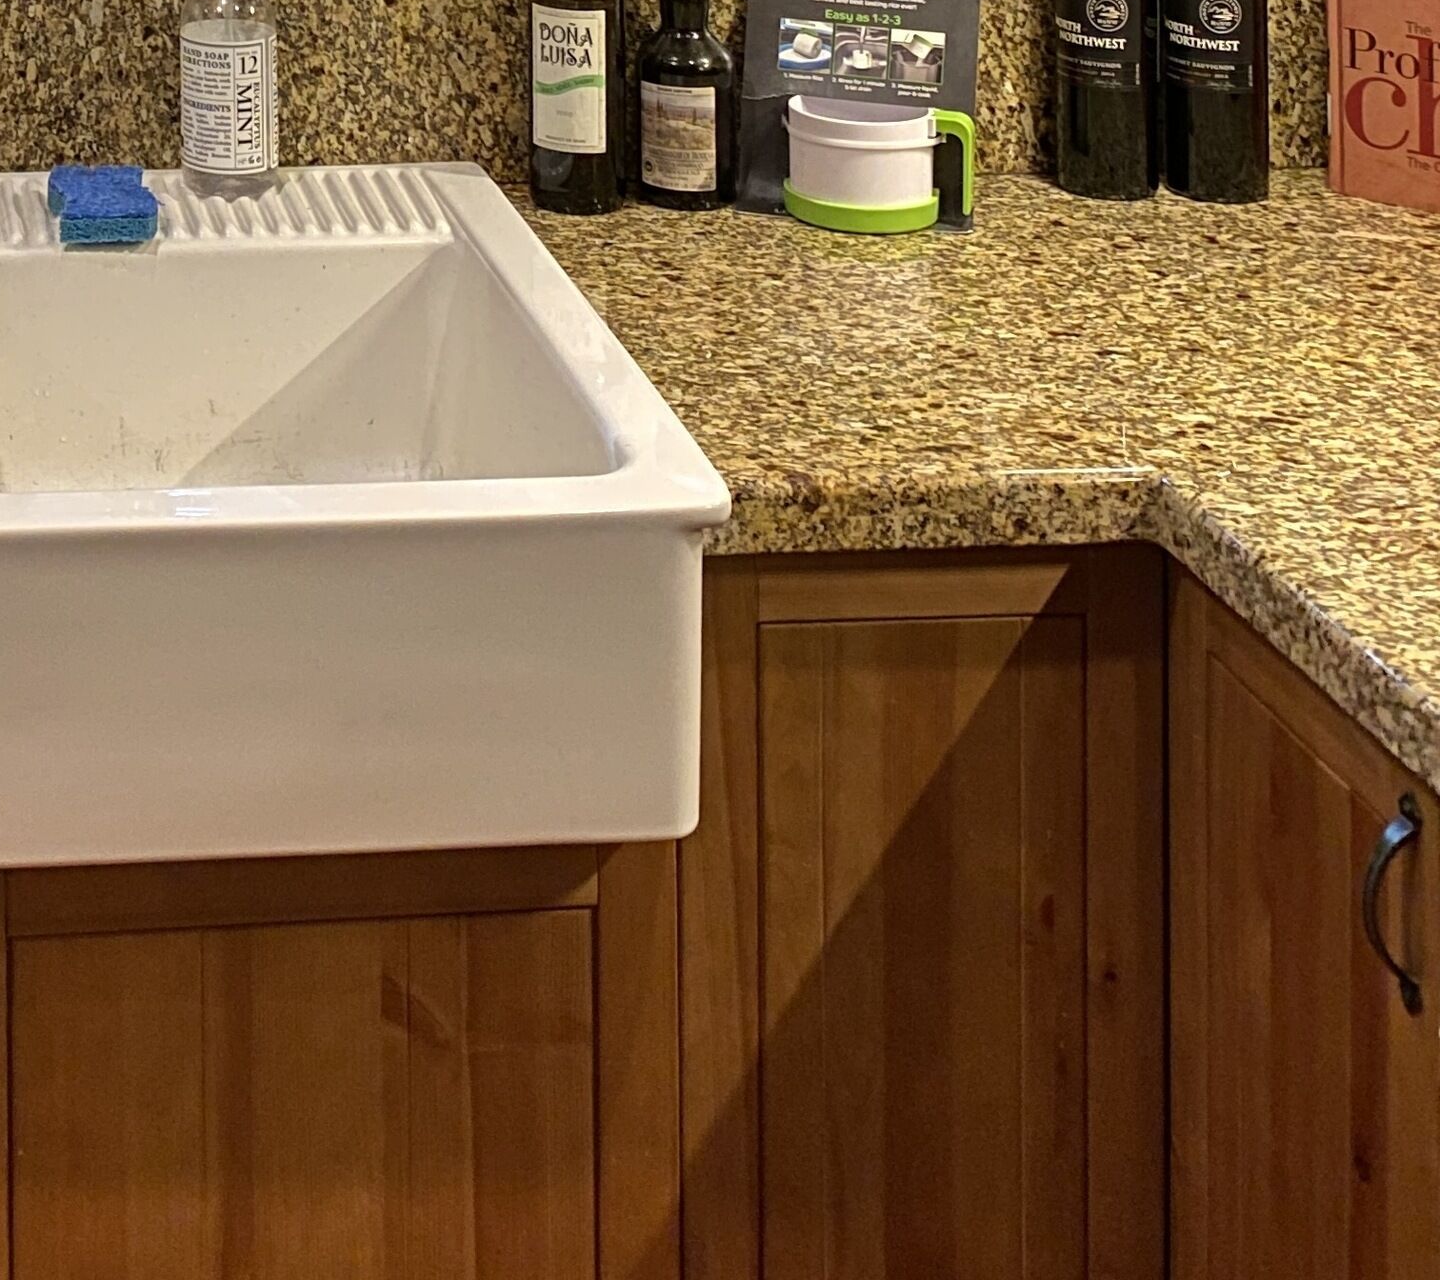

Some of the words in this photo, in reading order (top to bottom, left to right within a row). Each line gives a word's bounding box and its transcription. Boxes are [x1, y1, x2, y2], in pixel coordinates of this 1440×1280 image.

[824, 9, 855, 24] Easy
[855, 12, 870, 23] as
[871, 13, 902, 26] 1-2-3
[539, 22, 594, 48] DOÑA
[1405, 20, 1432, 36] The
[1059, 29, 1128, 51] NORTHWEST
[1169, 32, 1241, 52] NORTHWEST
[204, 50, 230, 61] SOAP
[239, 55, 259, 75] 12
[539, 42, 593, 69] LUISA
[236, 83, 254, 151] MINT
[253, 81, 261, 150] EUCALYPTUS
[1406, 155, 1431, 172] The
